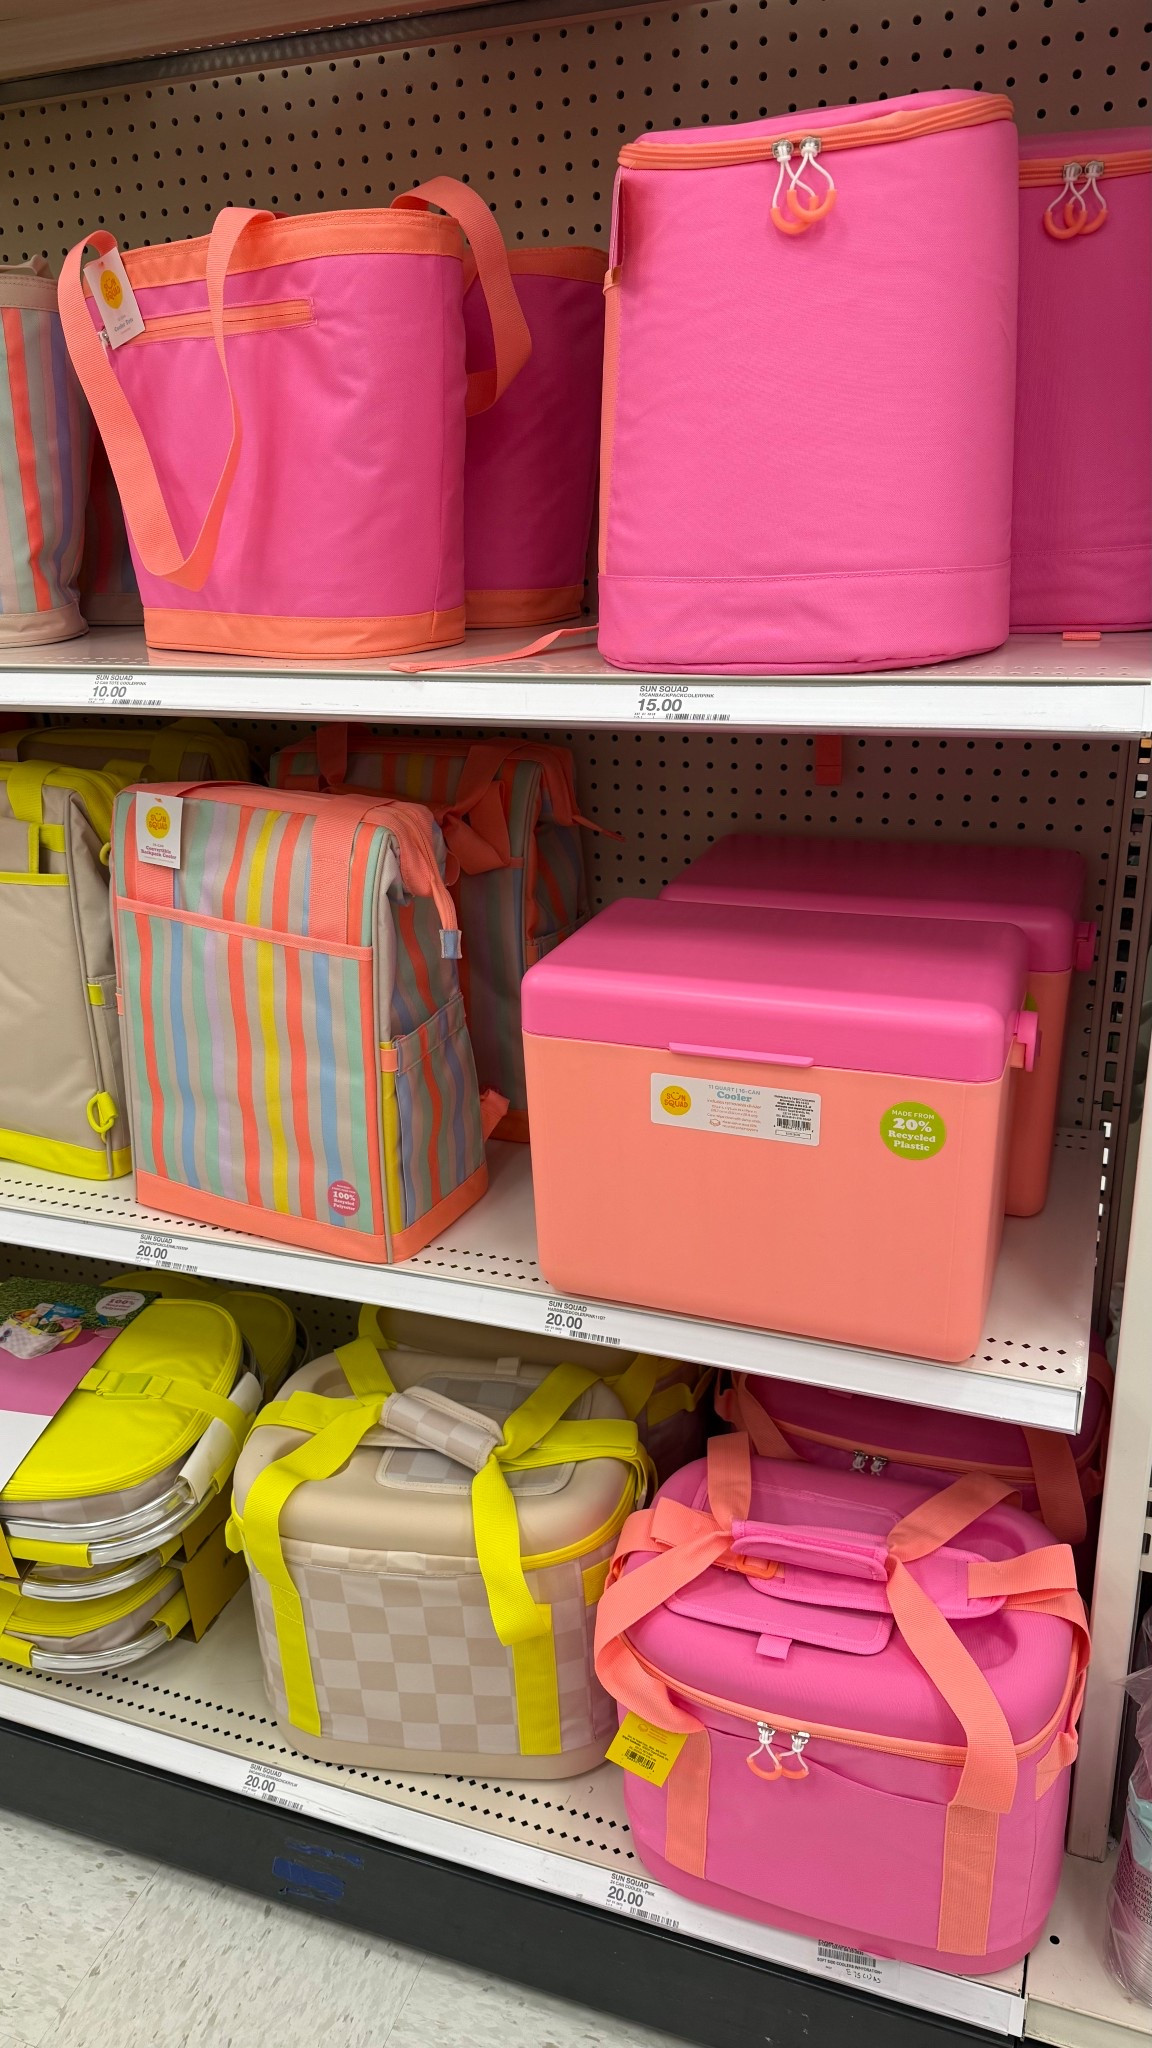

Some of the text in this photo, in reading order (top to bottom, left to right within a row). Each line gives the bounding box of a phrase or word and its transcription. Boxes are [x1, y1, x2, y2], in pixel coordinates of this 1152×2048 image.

[93, 685, 127, 698] 10.00
[659, 685, 689, 693] SQUAD
[638, 698, 683, 712] 15.00
[150, 812, 167, 823] SUN
[148, 820, 168, 831] SQUAD
[666, 1091, 687, 1101] SUN
[716, 1091, 753, 1103] Cooler
[664, 1099, 689, 1109] SQUAD
[891, 1109, 935, 1120] MADE FROM
[892, 1117, 933, 1133] 20%
[888, 1129, 936, 1143] Recycled
[893, 1139, 930, 1151] Plastic
[333, 1190, 356, 1201] 100%
[140, 1233, 173, 1244] SUN SQUAD
[136, 1244, 168, 1260] 20.00
[548, 1300, 588, 1312] SUN SQUAD
[545, 1312, 583, 1330] 20.00
[249, 1763, 283, 1778] SUN SQUAD
[244, 1774, 276, 1793] 20.00
[611, 1872, 649, 1890] SUN SQUAD
[624, 1883, 642, 1893] COOLER
[607, 1885, 644, 1907] 20.00
[836, 1961, 855, 1969] COOLERS
